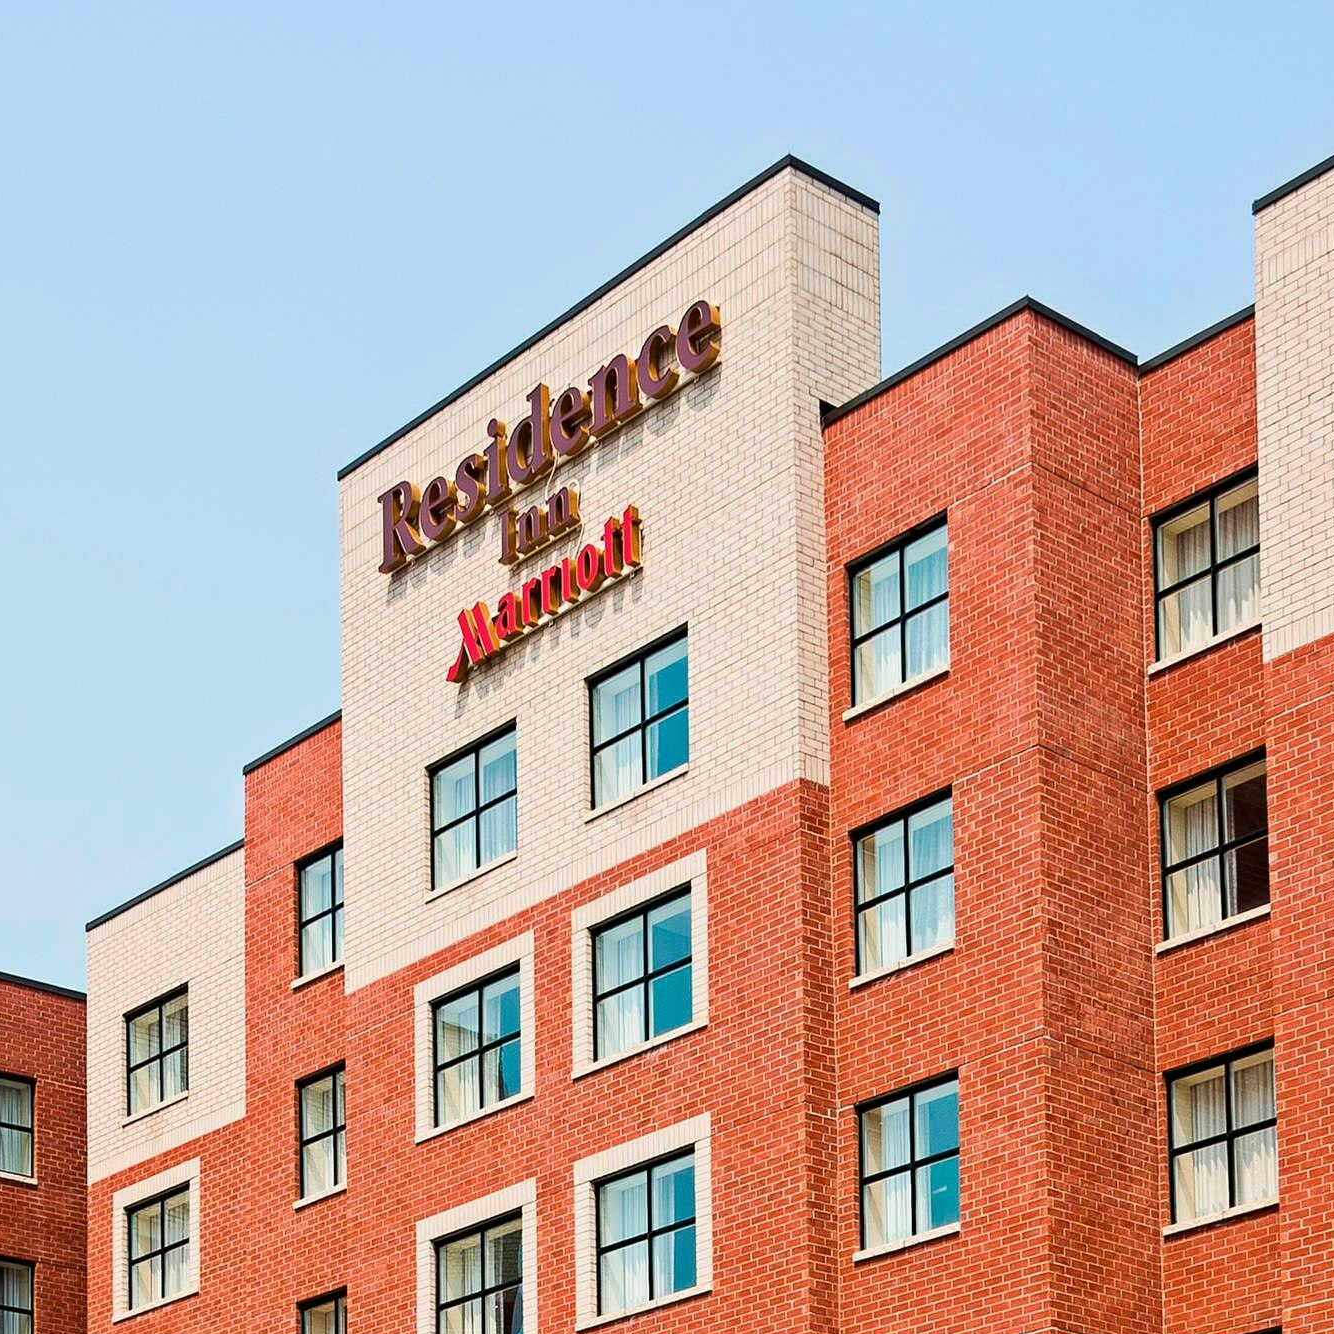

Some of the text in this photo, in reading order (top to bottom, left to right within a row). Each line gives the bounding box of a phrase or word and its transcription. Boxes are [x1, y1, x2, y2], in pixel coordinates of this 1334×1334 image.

[377, 299, 721, 574] Residence
[498, 486, 580, 566] Inn
[446, 504, 643, 683] Marriott
